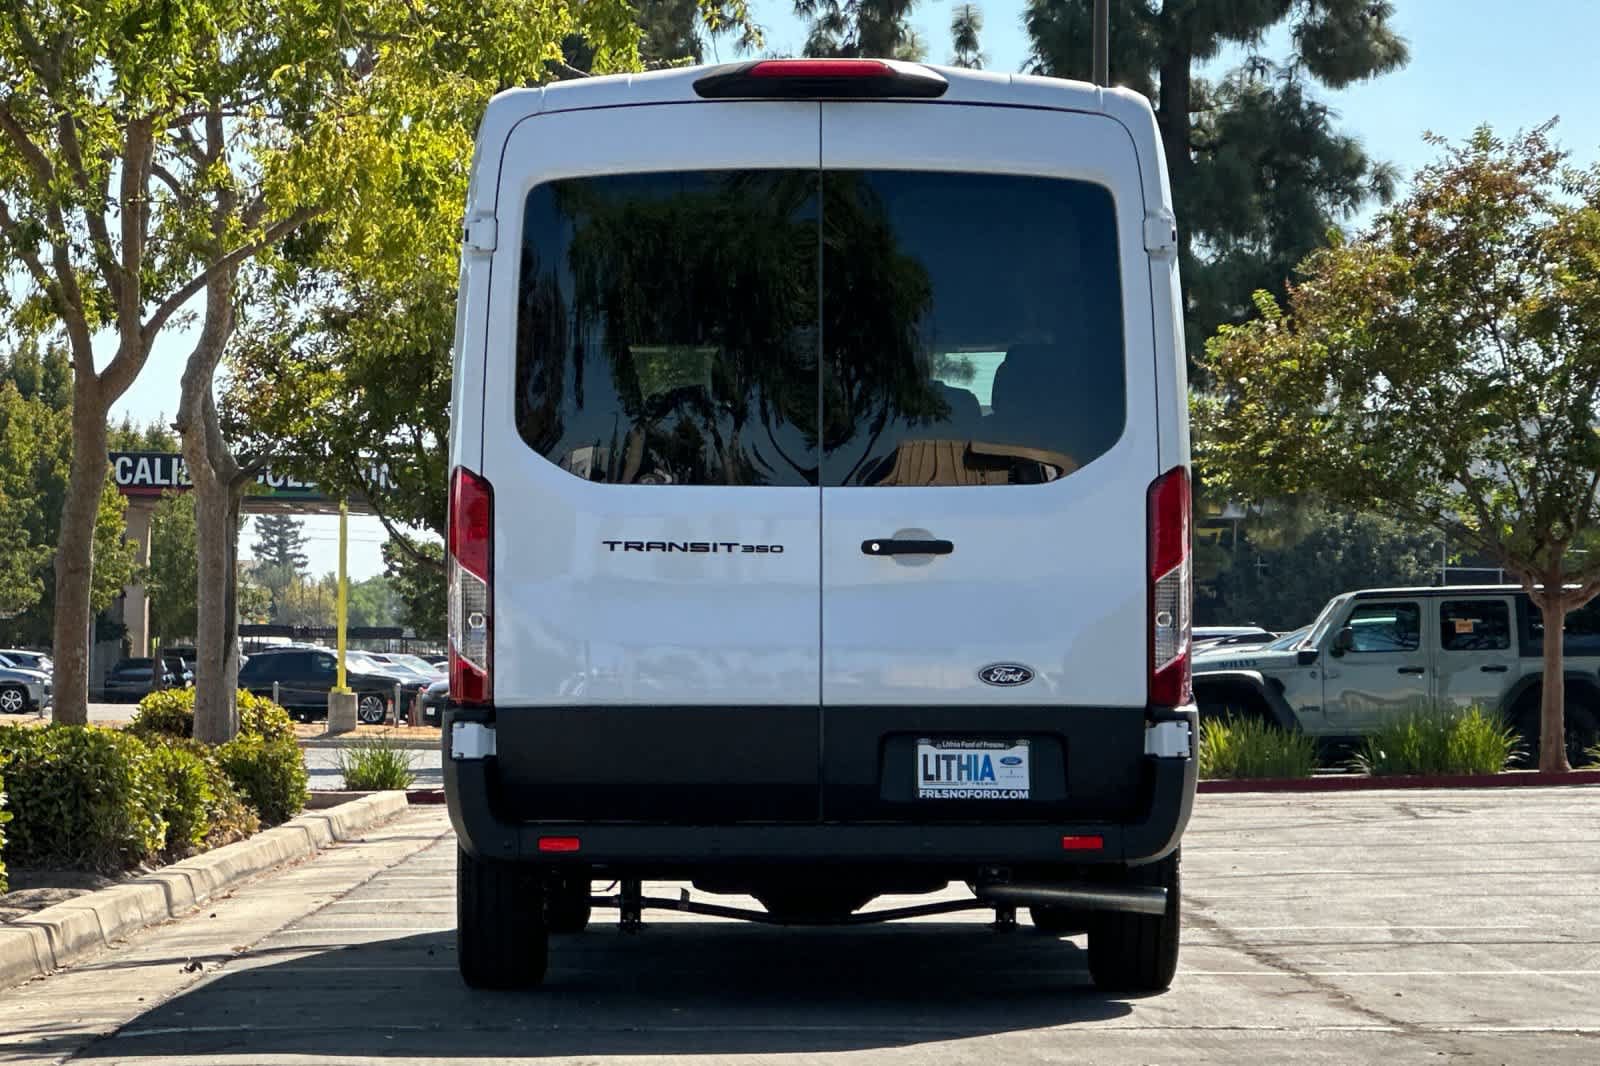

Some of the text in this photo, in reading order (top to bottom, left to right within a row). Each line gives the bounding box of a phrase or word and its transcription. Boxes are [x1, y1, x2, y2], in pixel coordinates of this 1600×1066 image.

[602, 541, 785, 553] TRANSIT 350
[922, 754, 996, 781] LITHIA
[919, 789, 1029, 799] FRESNOFORD.COM
